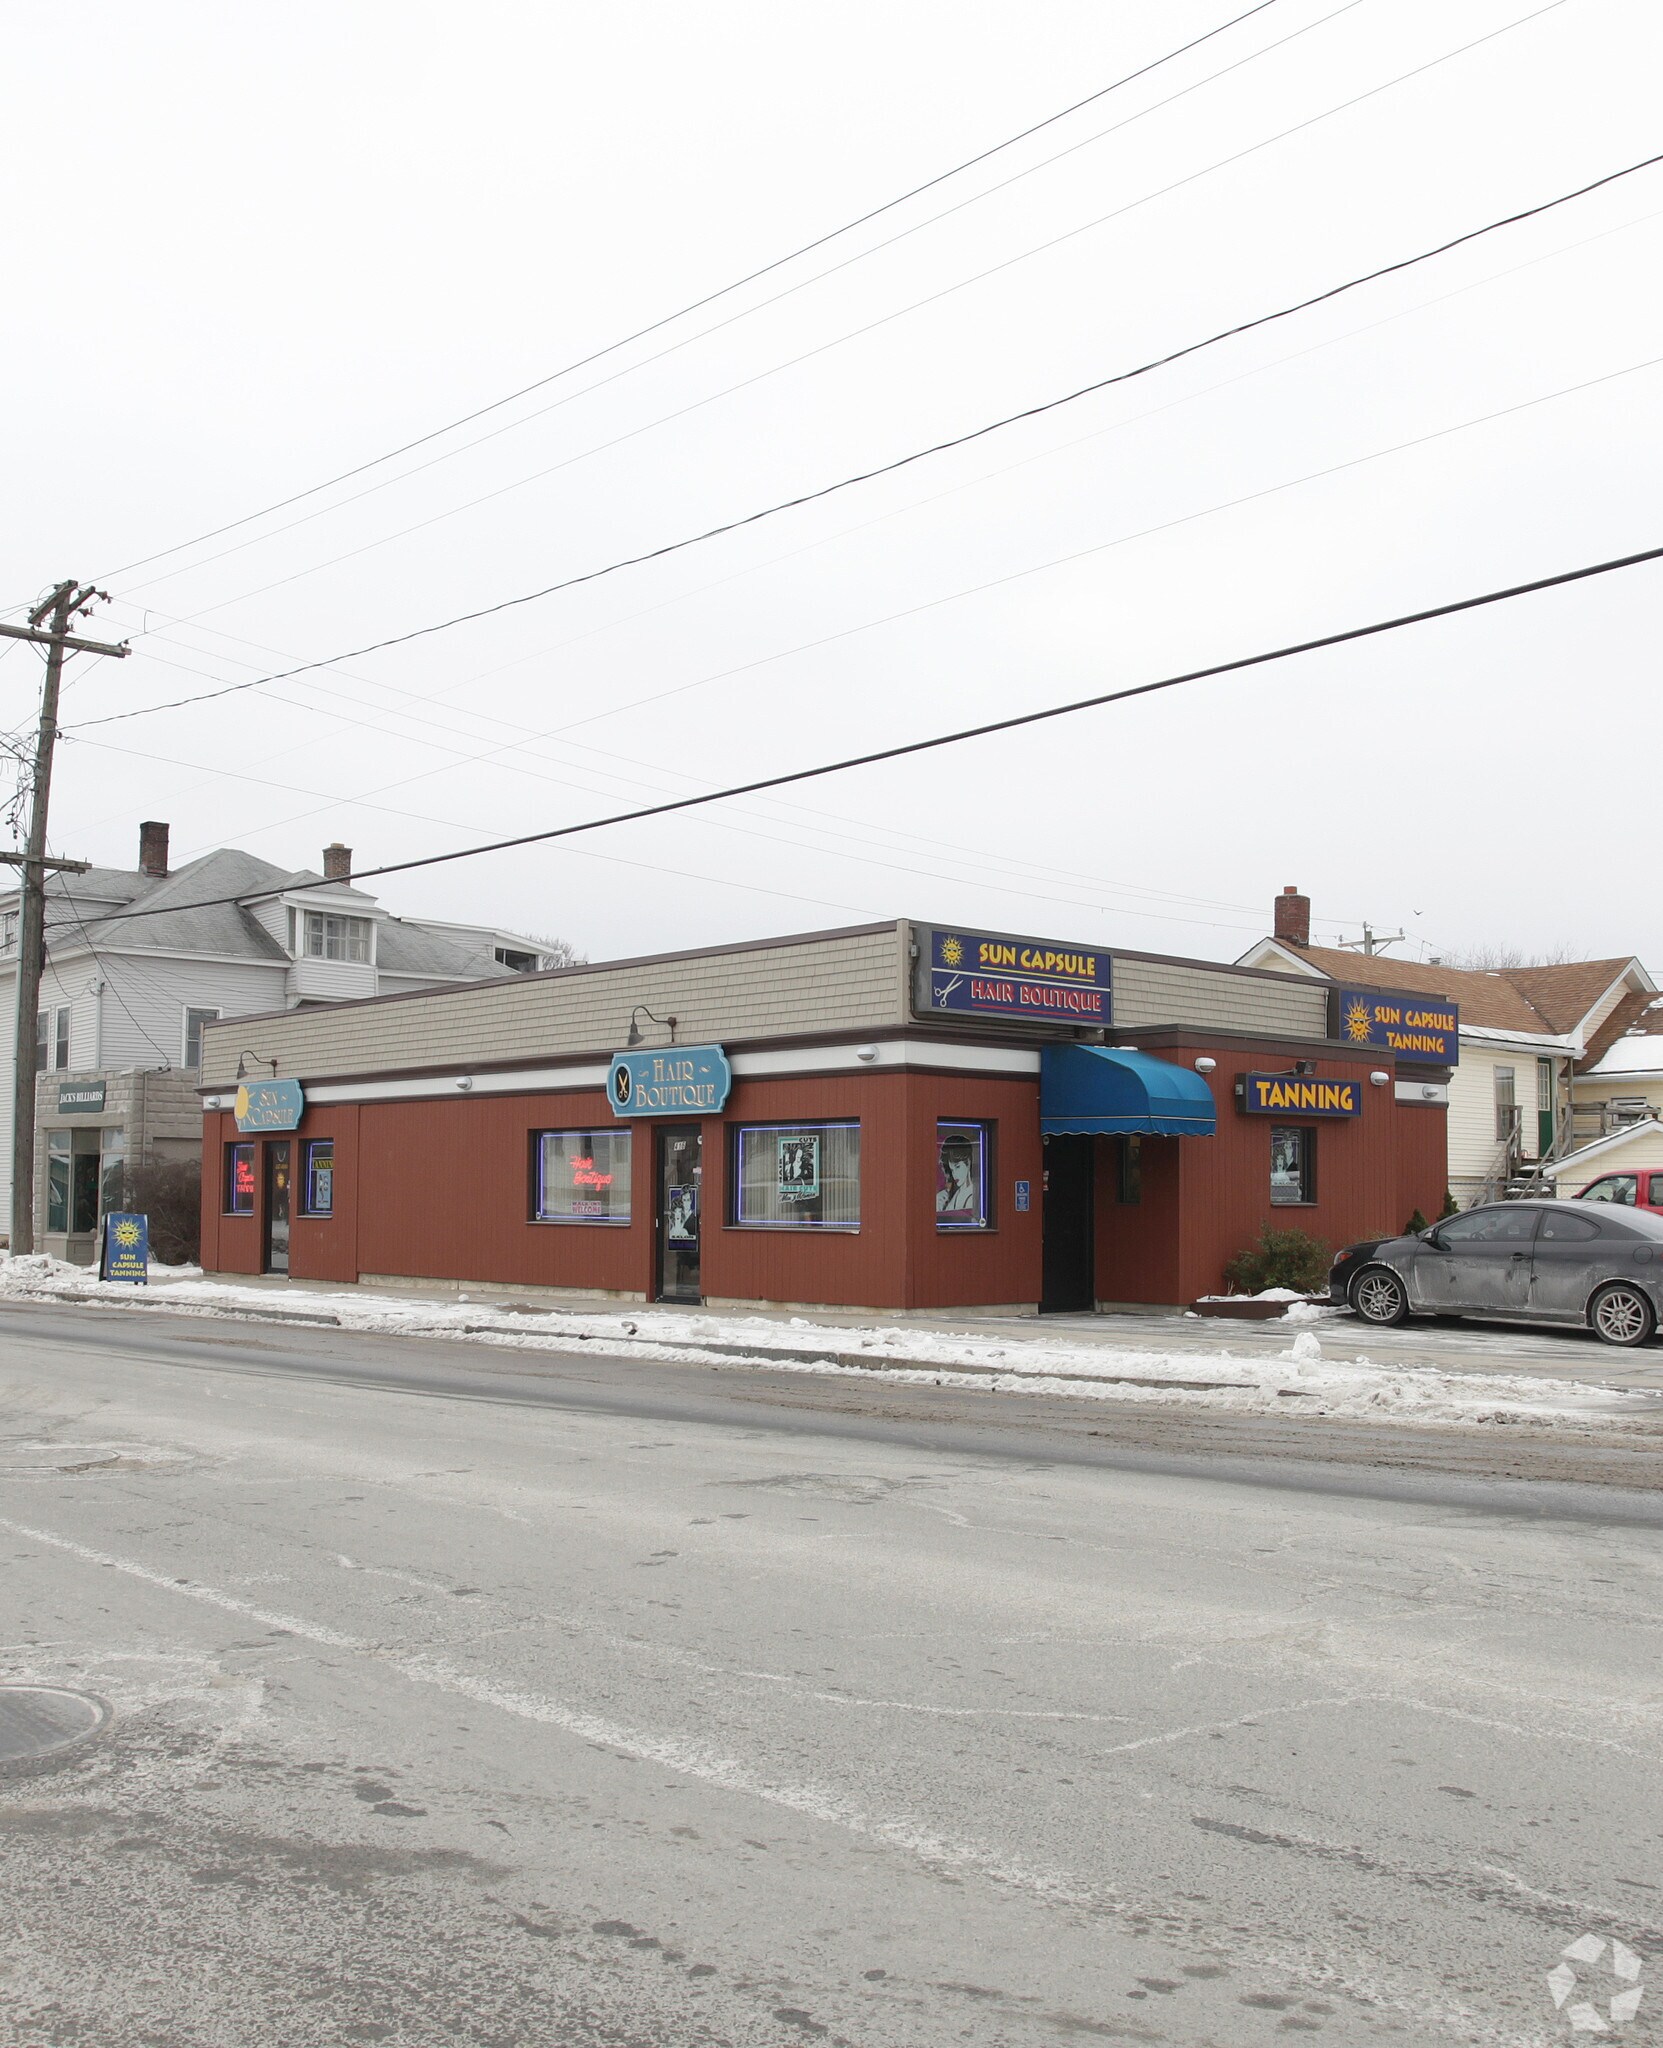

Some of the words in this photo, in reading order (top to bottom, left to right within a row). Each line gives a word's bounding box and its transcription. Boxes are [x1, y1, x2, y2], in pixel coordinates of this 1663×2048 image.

[979, 943, 1016, 967] SUN
[1020, 949, 1096, 977] CAPSULE
[971, 980, 1015, 1002] HAIR
[1020, 985, 1101, 1013] BOUTIQUE
[1375, 1006, 1401, 1025] SUN
[1405, 1009, 1455, 1031] CAPSULE
[1386, 1031, 1445, 1054] TANNING
[653, 1059, 695, 1081] HAIR
[59, 1092, 76, 1104] JACK'S
[76, 1090, 103, 1102] BILLIARDS
[635, 1083, 715, 1108] BOUTIQUE
[1256, 1081, 1353, 1110] TANNING
[252, 1107, 293, 1126] CAPSULE
[112, 1262, 144, 1270] CAPSULE
[120, 1253, 136, 1261] SUN
[110, 1270, 146, 1278] TANNING
